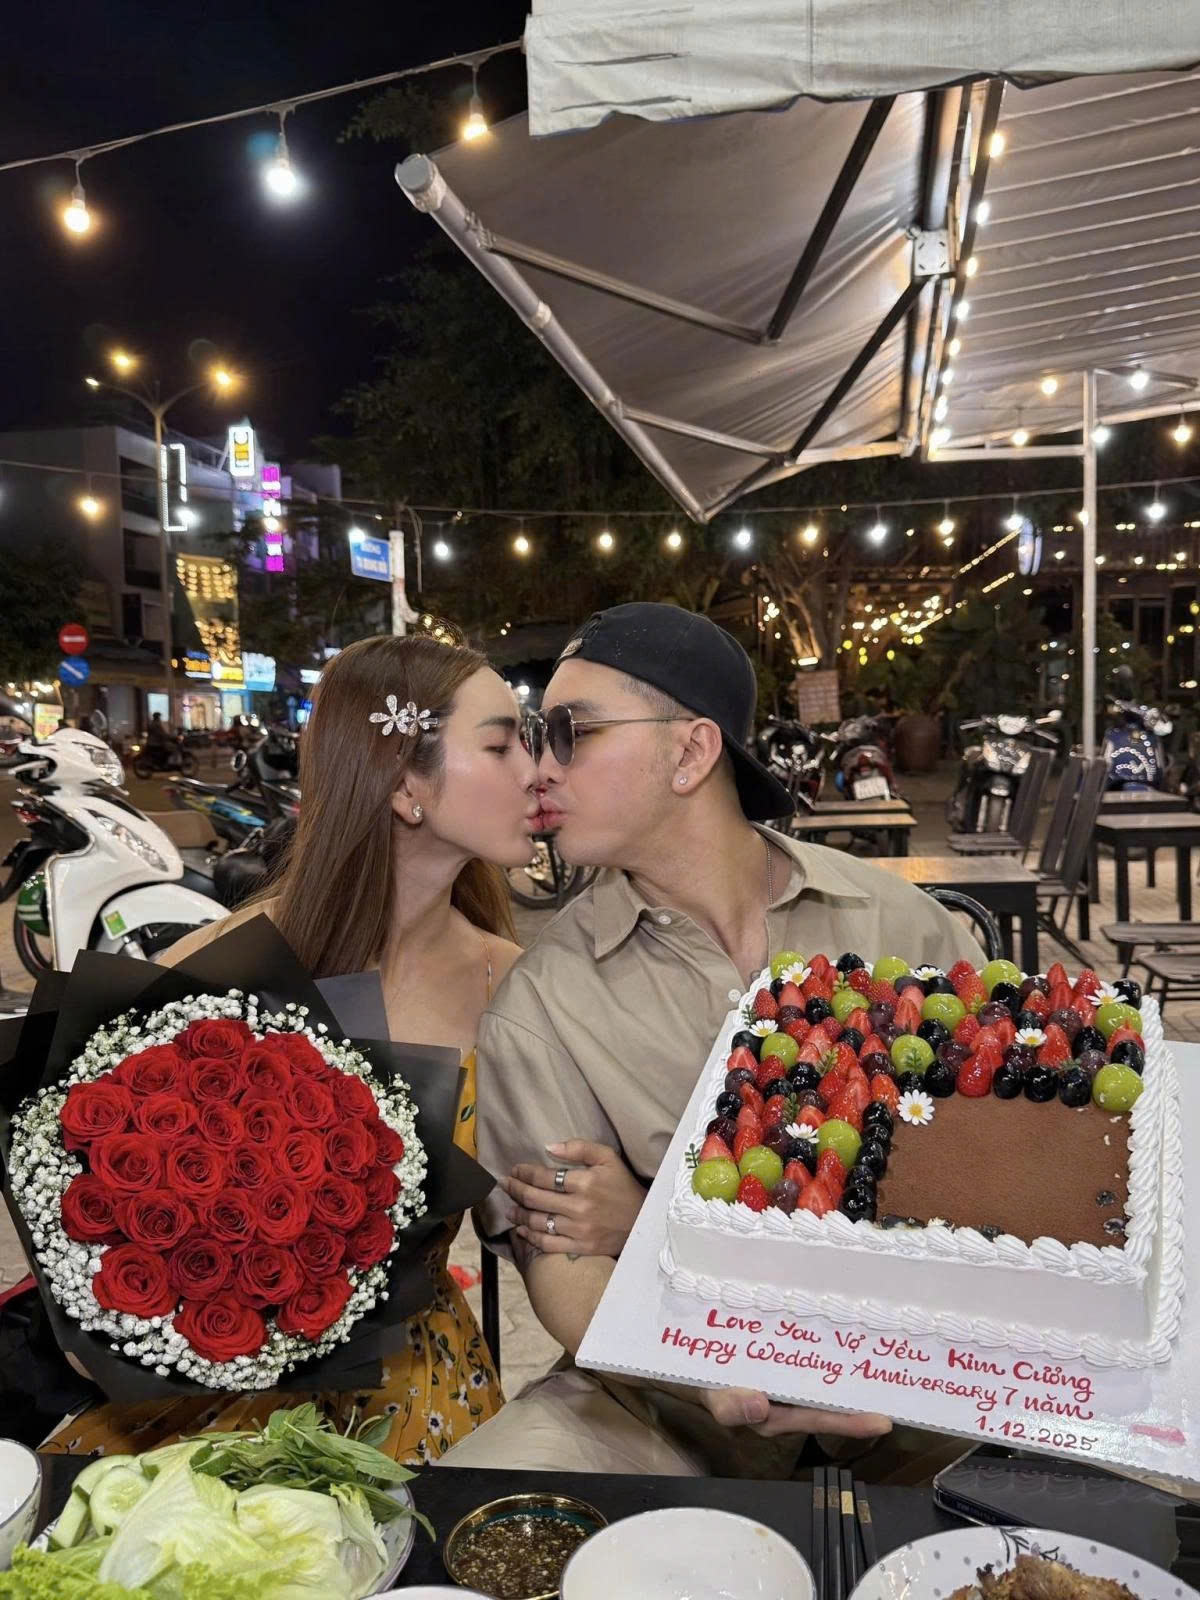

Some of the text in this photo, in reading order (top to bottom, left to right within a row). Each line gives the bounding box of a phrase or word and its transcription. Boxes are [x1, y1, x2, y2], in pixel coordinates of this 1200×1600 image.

[661, 1327, 737, 1364] Happy
[746, 1340, 843, 1384] Wedding
[1003, 1386, 1018, 1406] 7
[1024, 1393, 1094, 1420] năm
[706, 1309, 764, 1333] Love
[774, 1320, 821, 1343] You
[835, 1331, 866, 1353] Vợ
[948, 1348, 1006, 1376] Kim
[975, 1415, 1099, 1451] 1.12.2025
